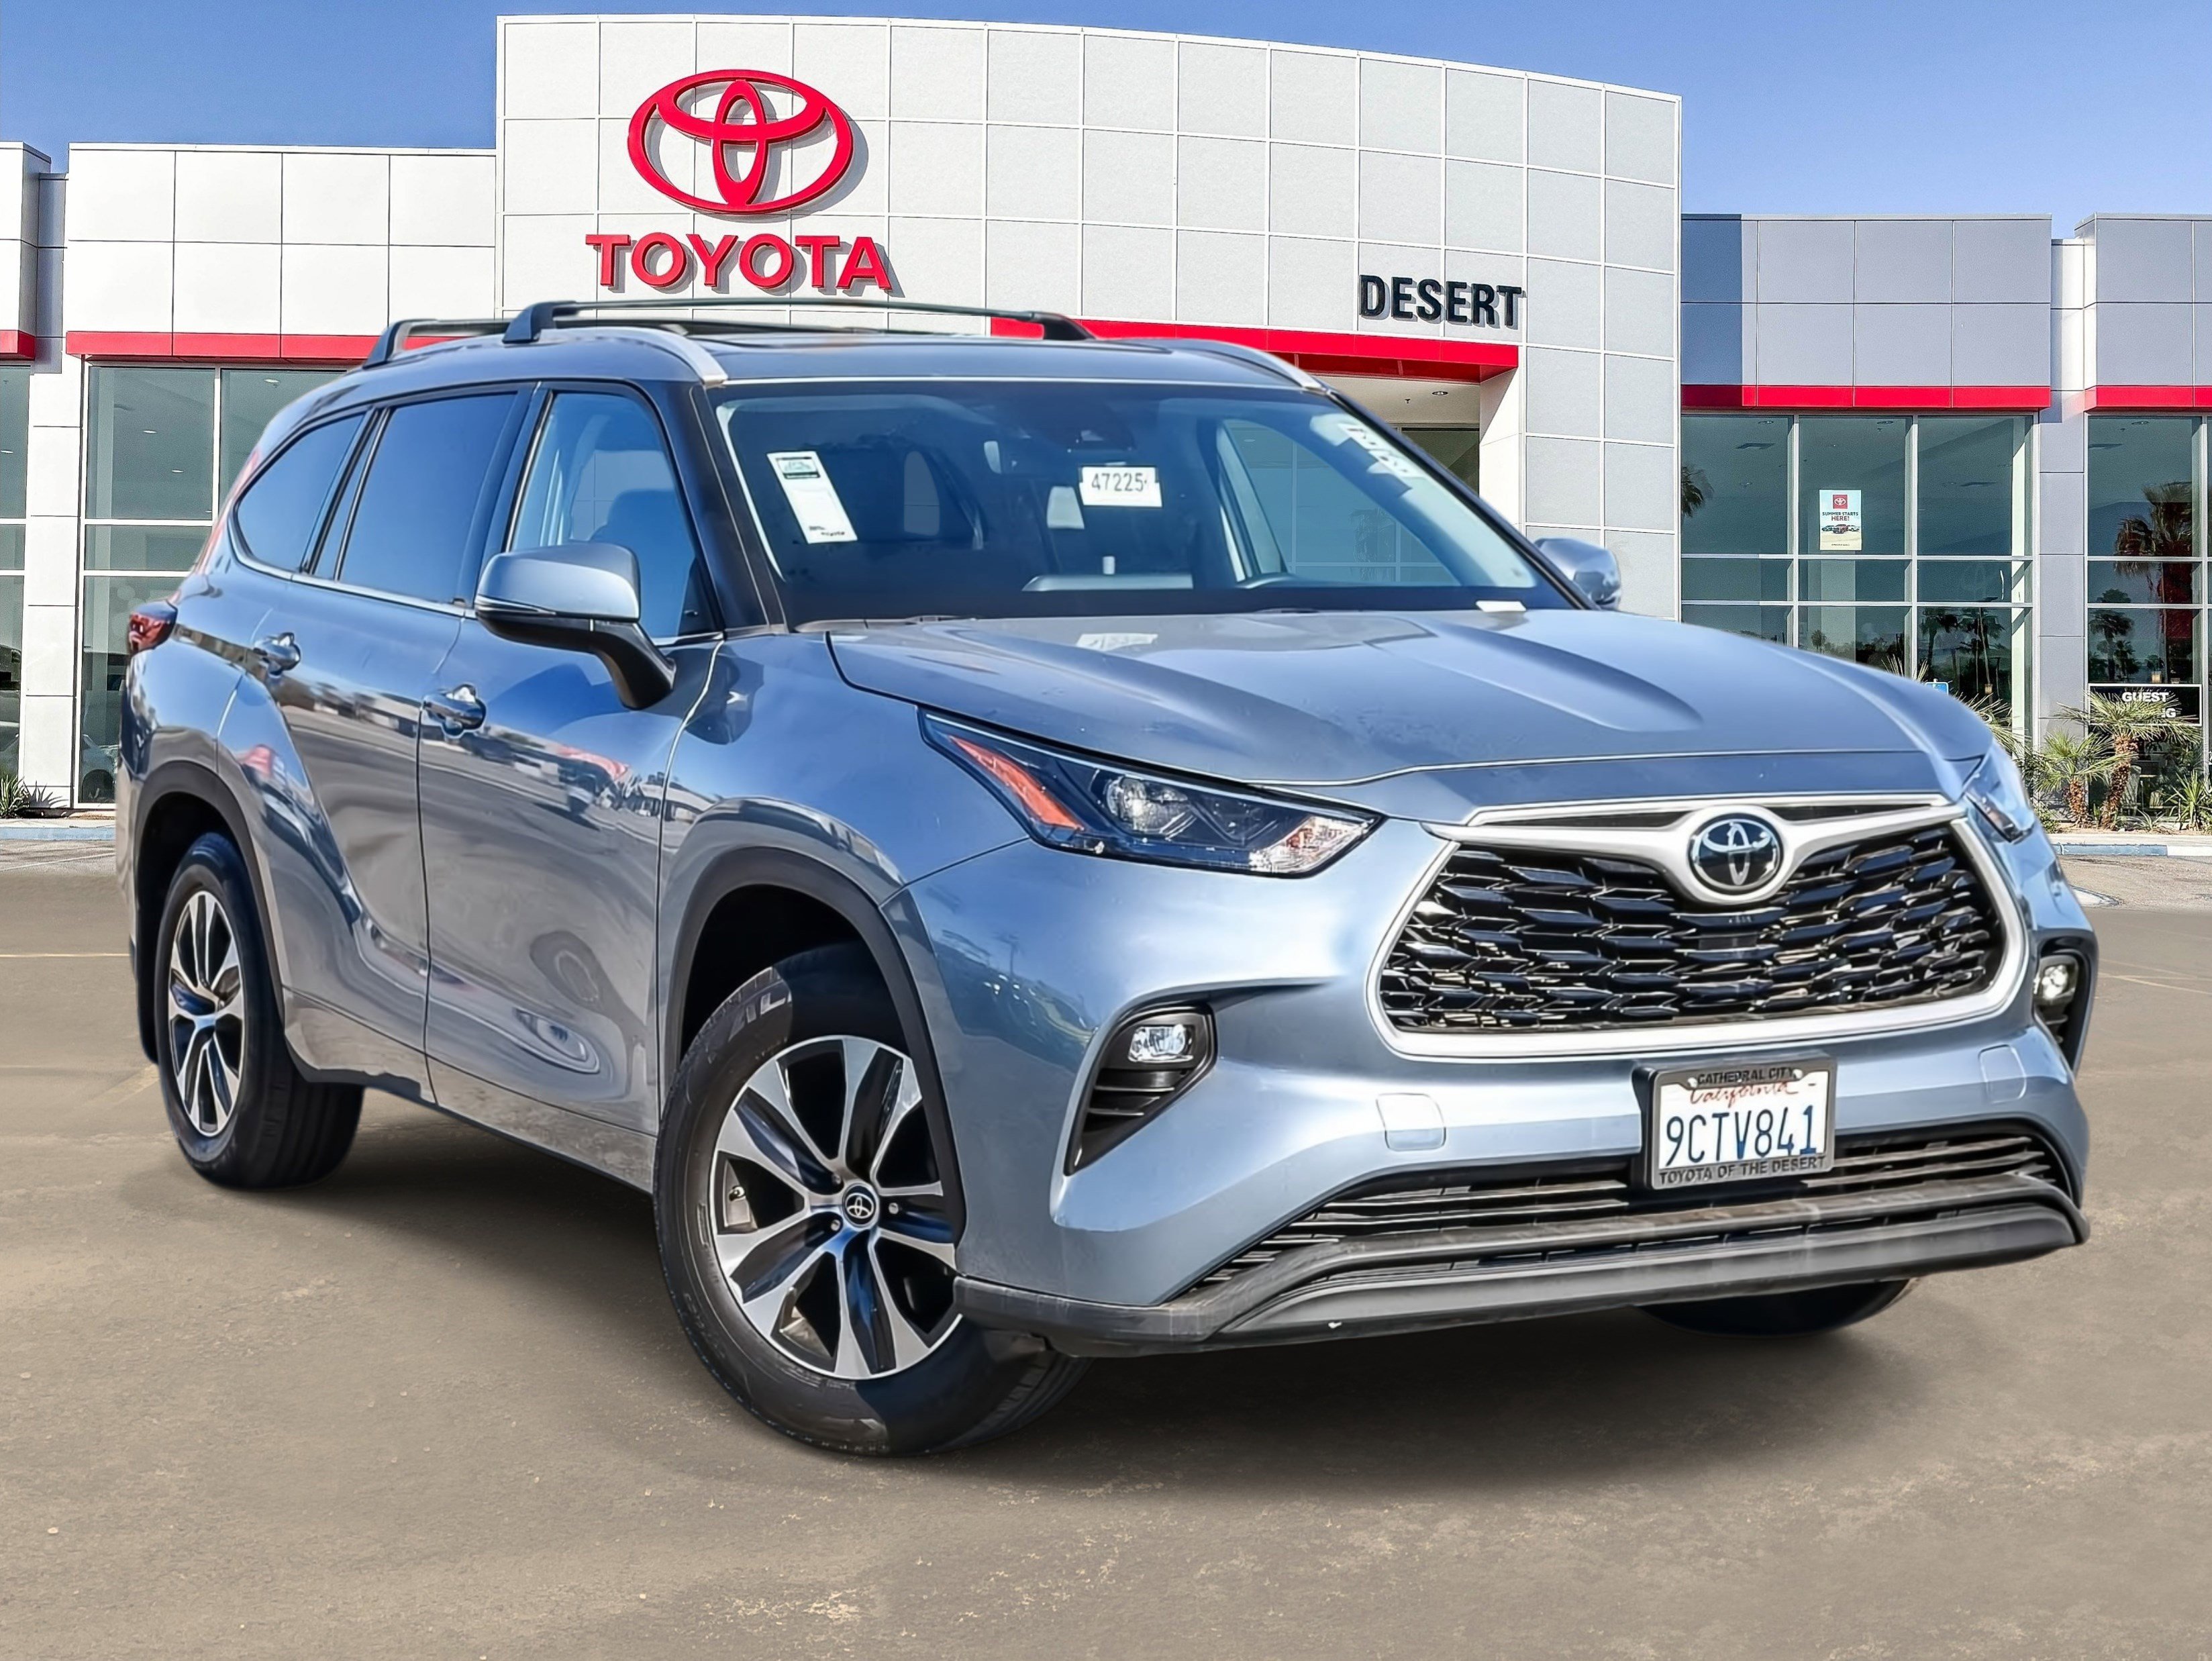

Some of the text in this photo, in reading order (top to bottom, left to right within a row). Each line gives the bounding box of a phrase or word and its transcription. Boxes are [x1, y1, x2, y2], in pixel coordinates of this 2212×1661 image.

[585, 232, 893, 290] TOYOTA
[1359, 274, 1523, 327] DESERT
[2121, 691, 2169, 703] GUEST
[1697, 1066, 1796, 1085] CATHEDRAL CITY
[1666, 1105, 1816, 1166] 9CTV841
[1659, 1156, 1826, 1185] TOYOTA OF THE DESERT
